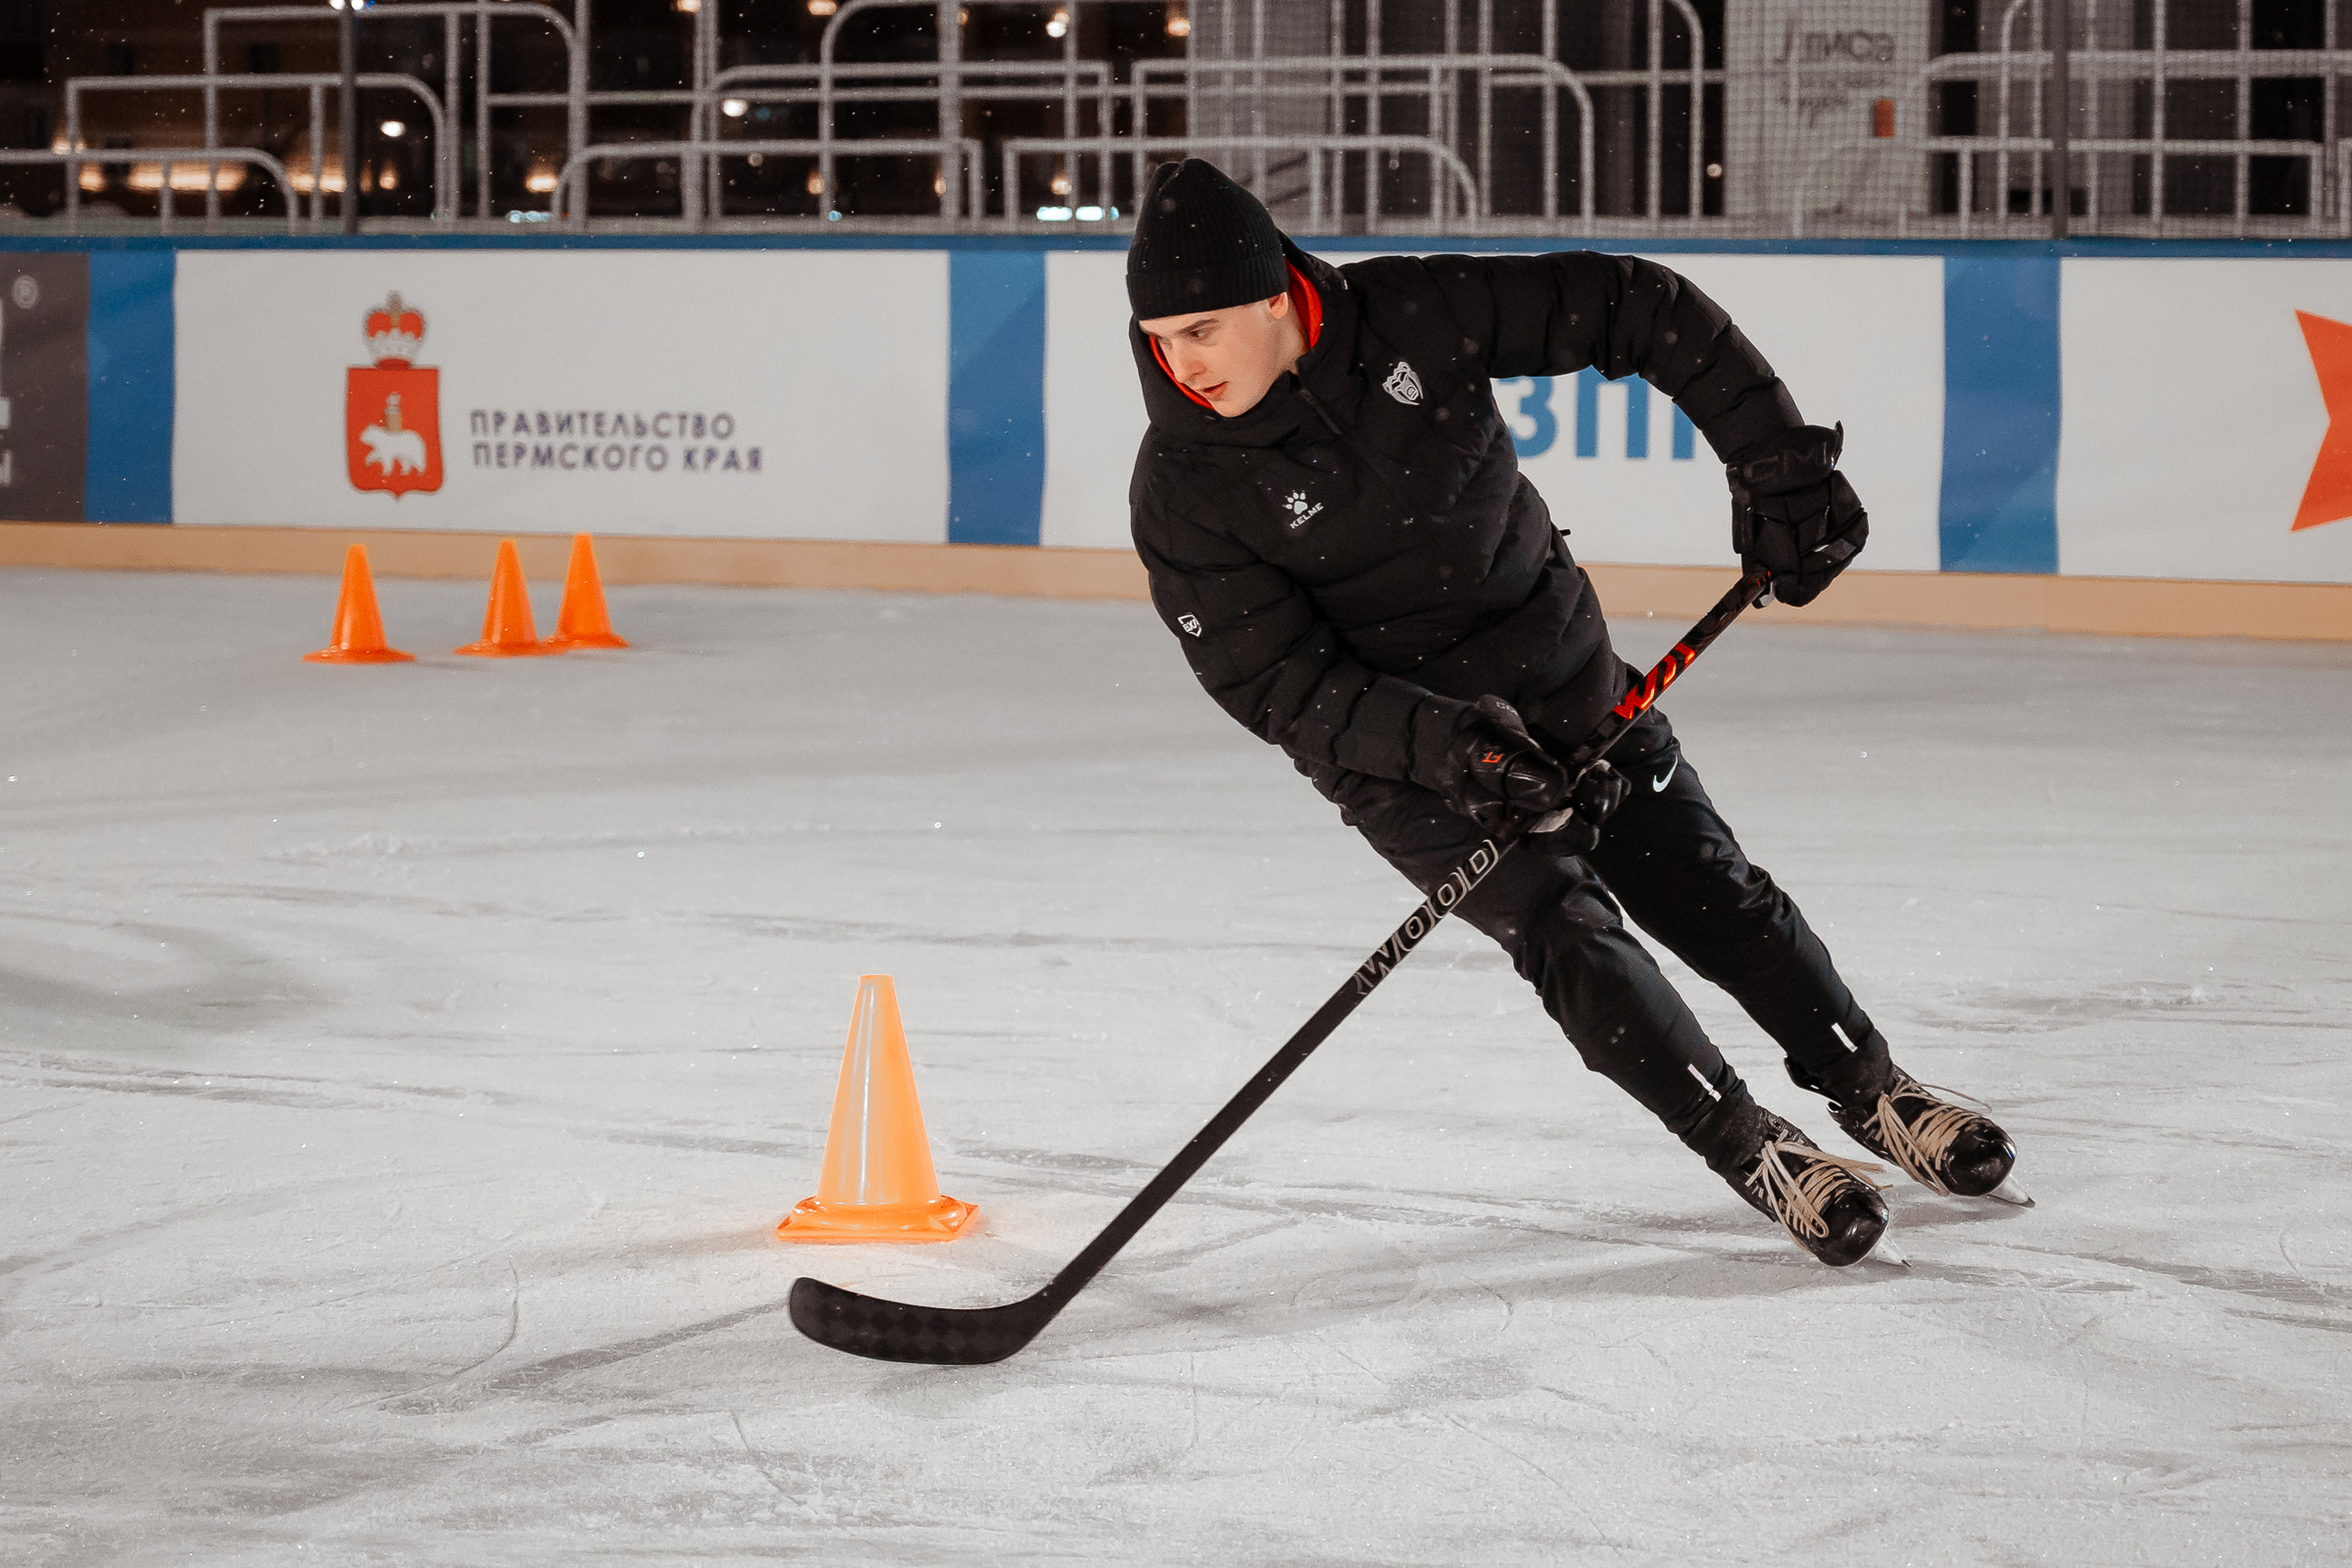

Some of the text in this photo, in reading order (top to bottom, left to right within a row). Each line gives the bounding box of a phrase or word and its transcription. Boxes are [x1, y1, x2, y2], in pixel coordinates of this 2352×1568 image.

[470, 409, 735, 440] ПРАВИТЕЛЬСТВО
[472, 441, 763, 473] ПЕРМСКОГО КРАЯ
[1290, 502, 1324, 529] KELME
